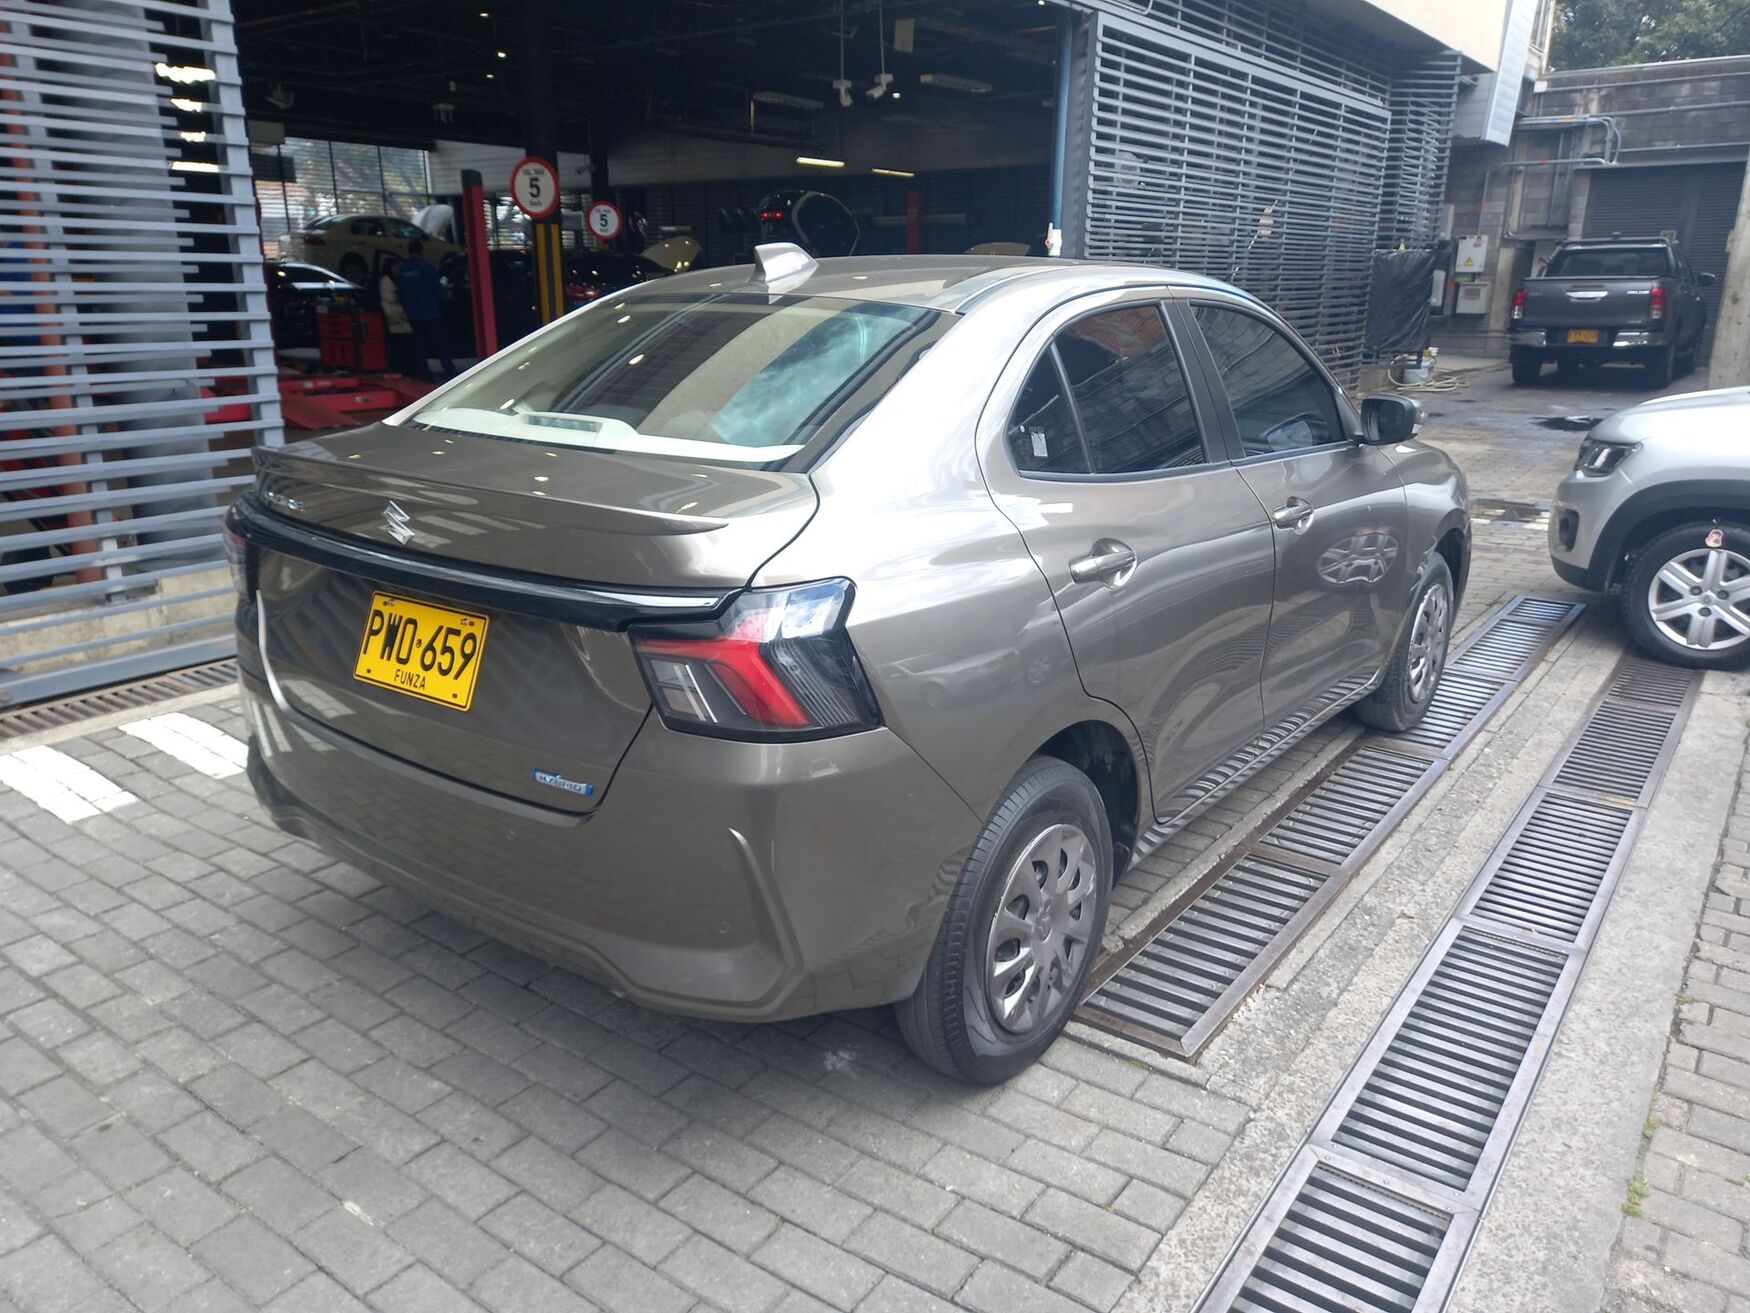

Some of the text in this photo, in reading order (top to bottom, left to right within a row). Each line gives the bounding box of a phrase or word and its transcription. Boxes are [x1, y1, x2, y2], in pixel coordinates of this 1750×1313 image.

[529, 177, 540, 198] 5
[600, 214, 608, 227] 5
[394, 669, 426, 690] FUNZA
